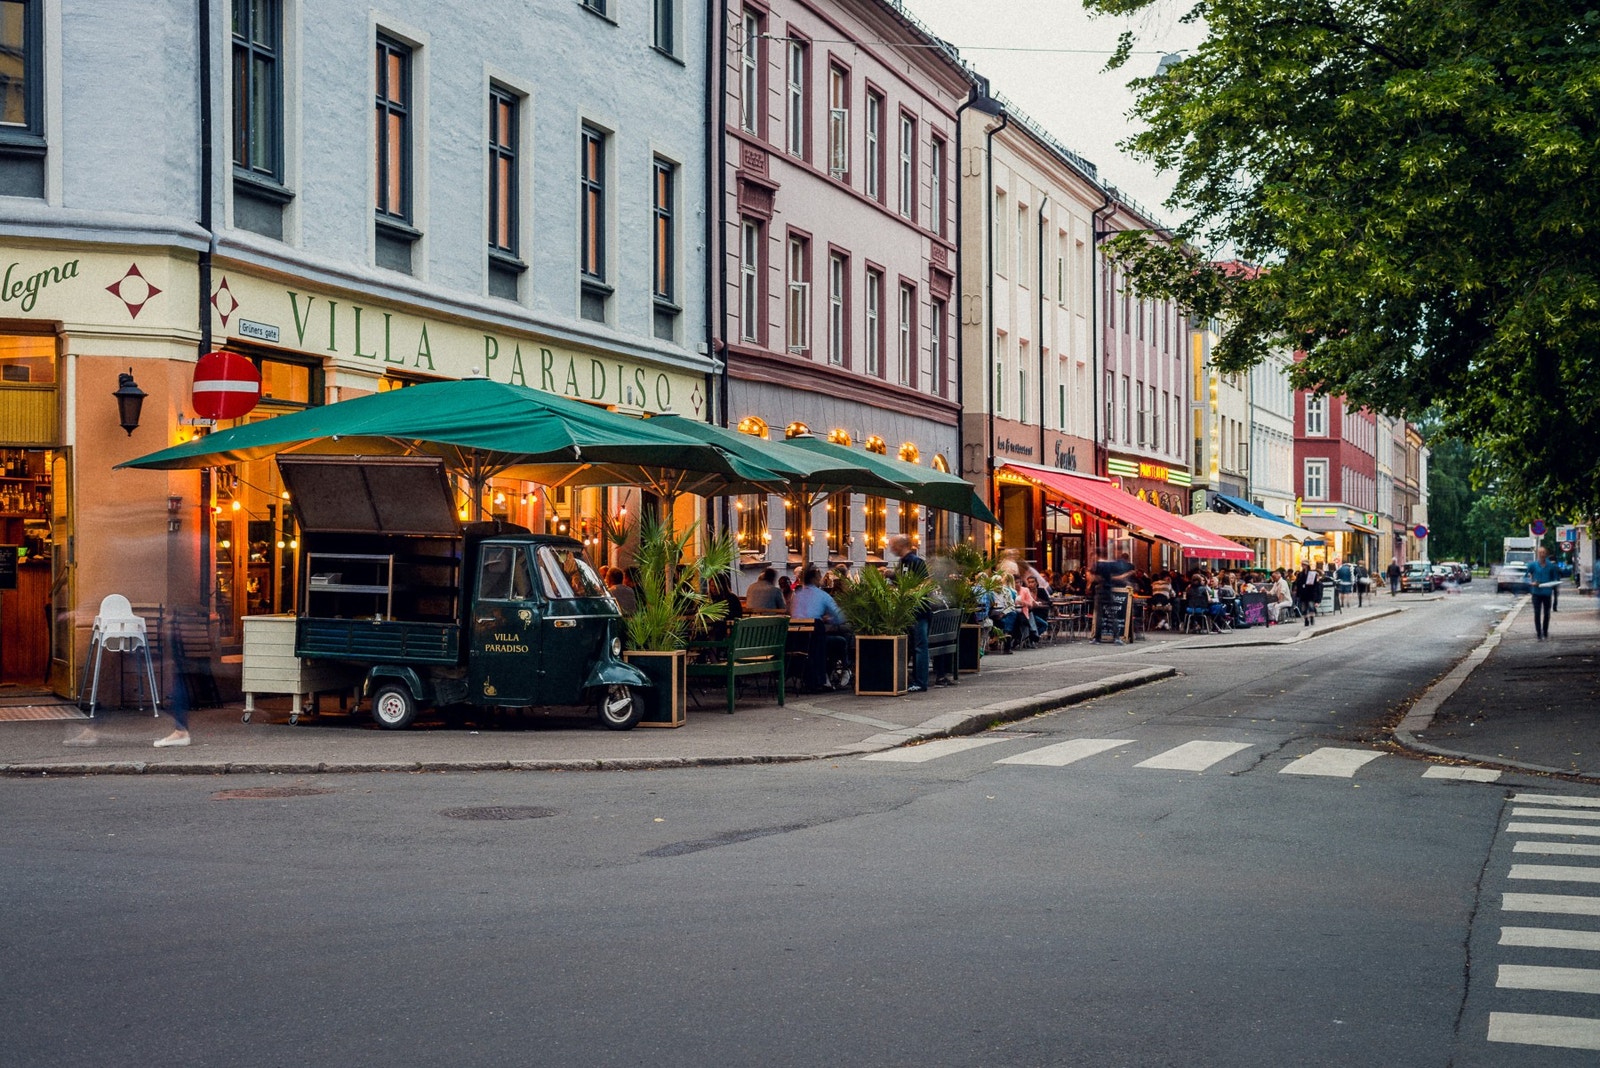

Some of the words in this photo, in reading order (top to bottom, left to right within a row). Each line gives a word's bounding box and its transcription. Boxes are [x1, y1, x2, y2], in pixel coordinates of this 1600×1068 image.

[1, 259, 80, 312] legna
[265, 329, 277, 339] gate
[287, 291, 436, 371] VILLA
[483, 334, 672, 412] PARADISO
[494, 633, 520, 642] VILLA
[485, 643, 529, 653] PARADISO
